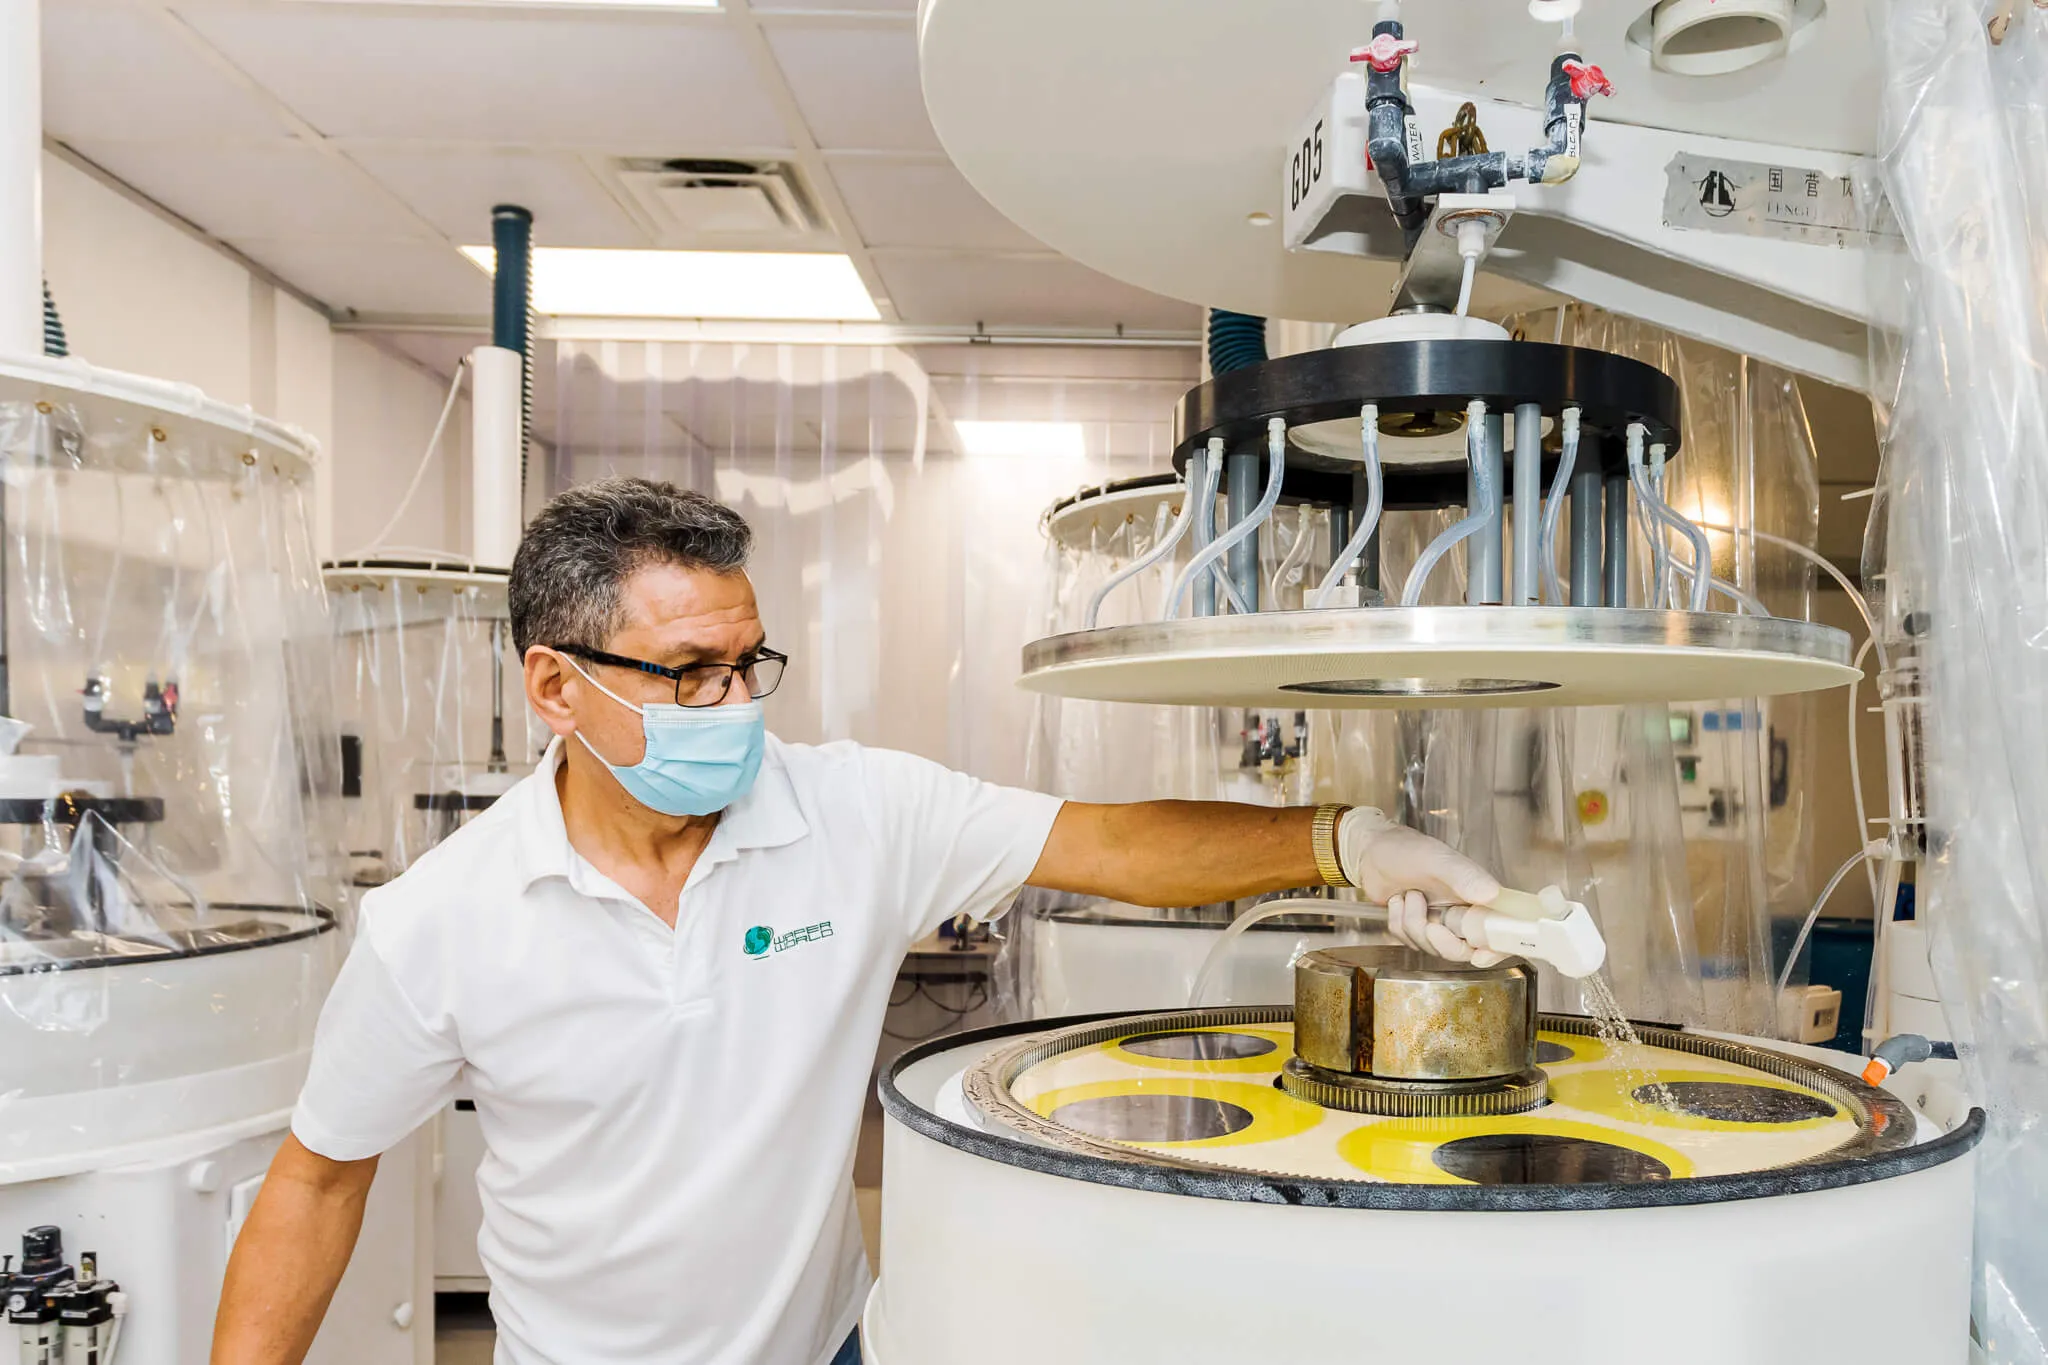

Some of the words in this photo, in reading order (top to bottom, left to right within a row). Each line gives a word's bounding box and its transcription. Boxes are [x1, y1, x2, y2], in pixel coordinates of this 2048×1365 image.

[1408, 122, 1421, 162] WATER
[1568, 113, 1579, 158] BLEACH
[1291, 119, 1323, 212] GD5
[774, 921, 832, 944] WAFER
[775, 928, 833, 952] WORLD
